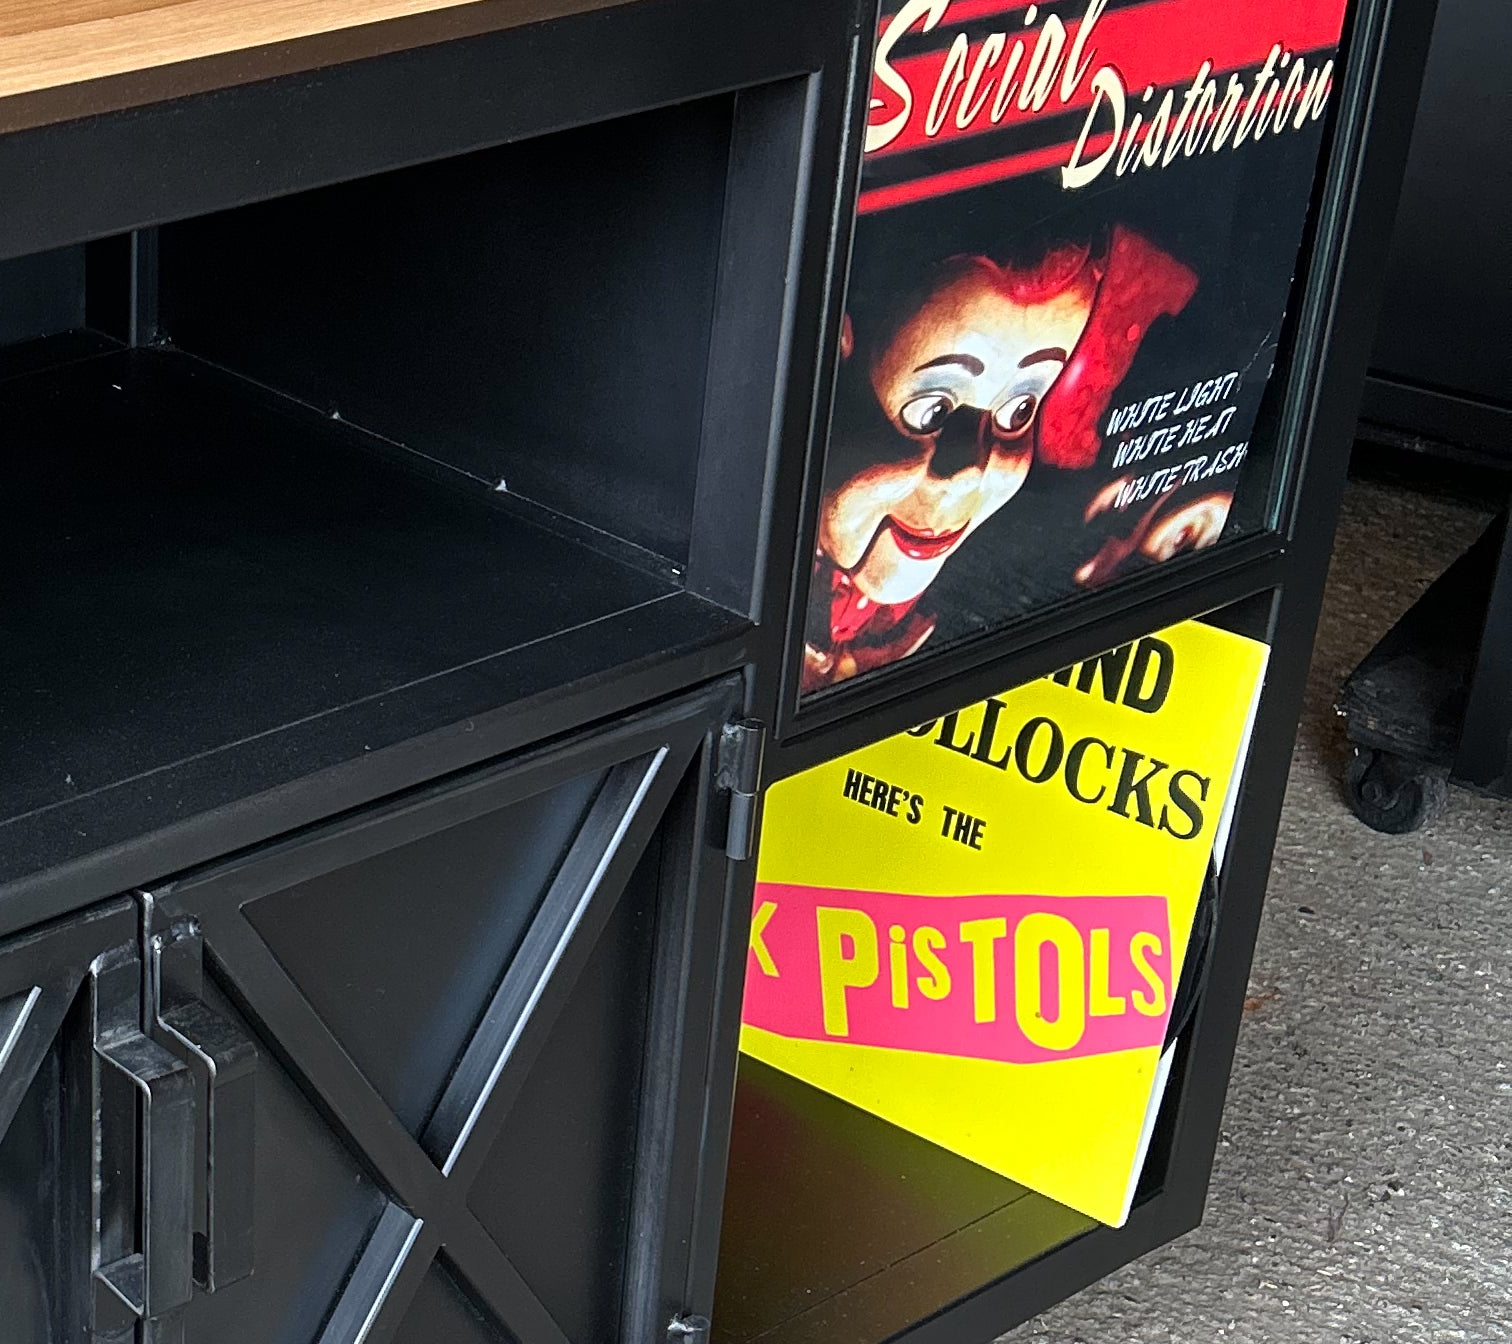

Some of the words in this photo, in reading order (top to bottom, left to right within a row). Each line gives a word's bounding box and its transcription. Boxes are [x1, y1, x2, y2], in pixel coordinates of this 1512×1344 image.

[1061, 47, 1338, 191] Distortion
[1106, 391, 1176, 436] WHITE
[1173, 372, 1239, 415] LIGHT
[1112, 424, 1181, 468] WHITE
[1177, 406, 1237, 448] HEAT
[1114, 465, 1183, 508] WHITE
[1182, 441, 1249, 486] TRASH
[905, 698, 1212, 841] LLOCKS
[843, 768, 924, 825] HERE'S
[941, 805, 987, 851] THE
